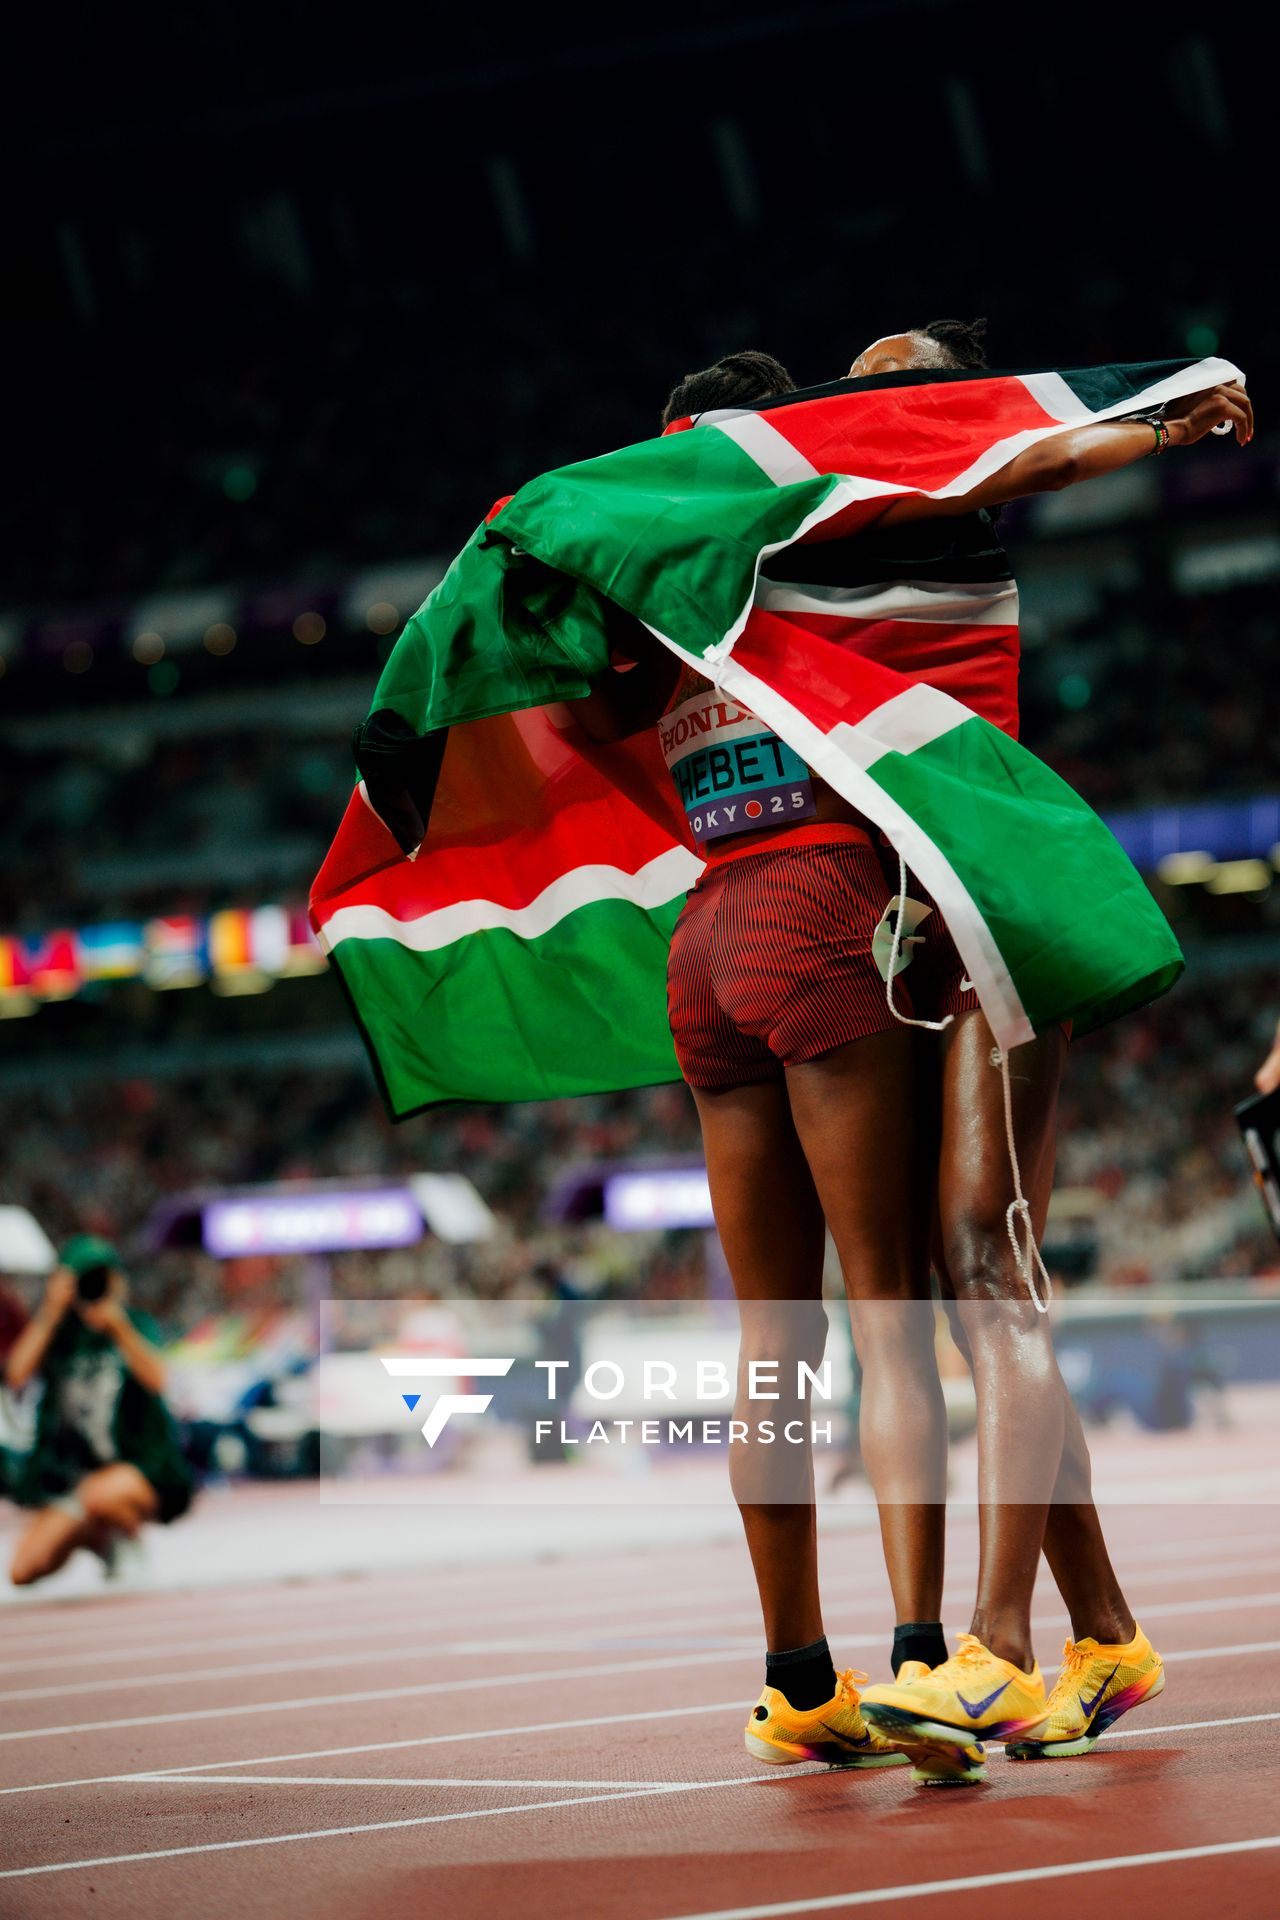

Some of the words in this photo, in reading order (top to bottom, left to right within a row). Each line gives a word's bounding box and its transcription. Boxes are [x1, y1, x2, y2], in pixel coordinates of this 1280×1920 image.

[661, 700, 755, 756] HOND
[672, 736, 783, 805] HEBET
[770, 792, 805, 813] 25
